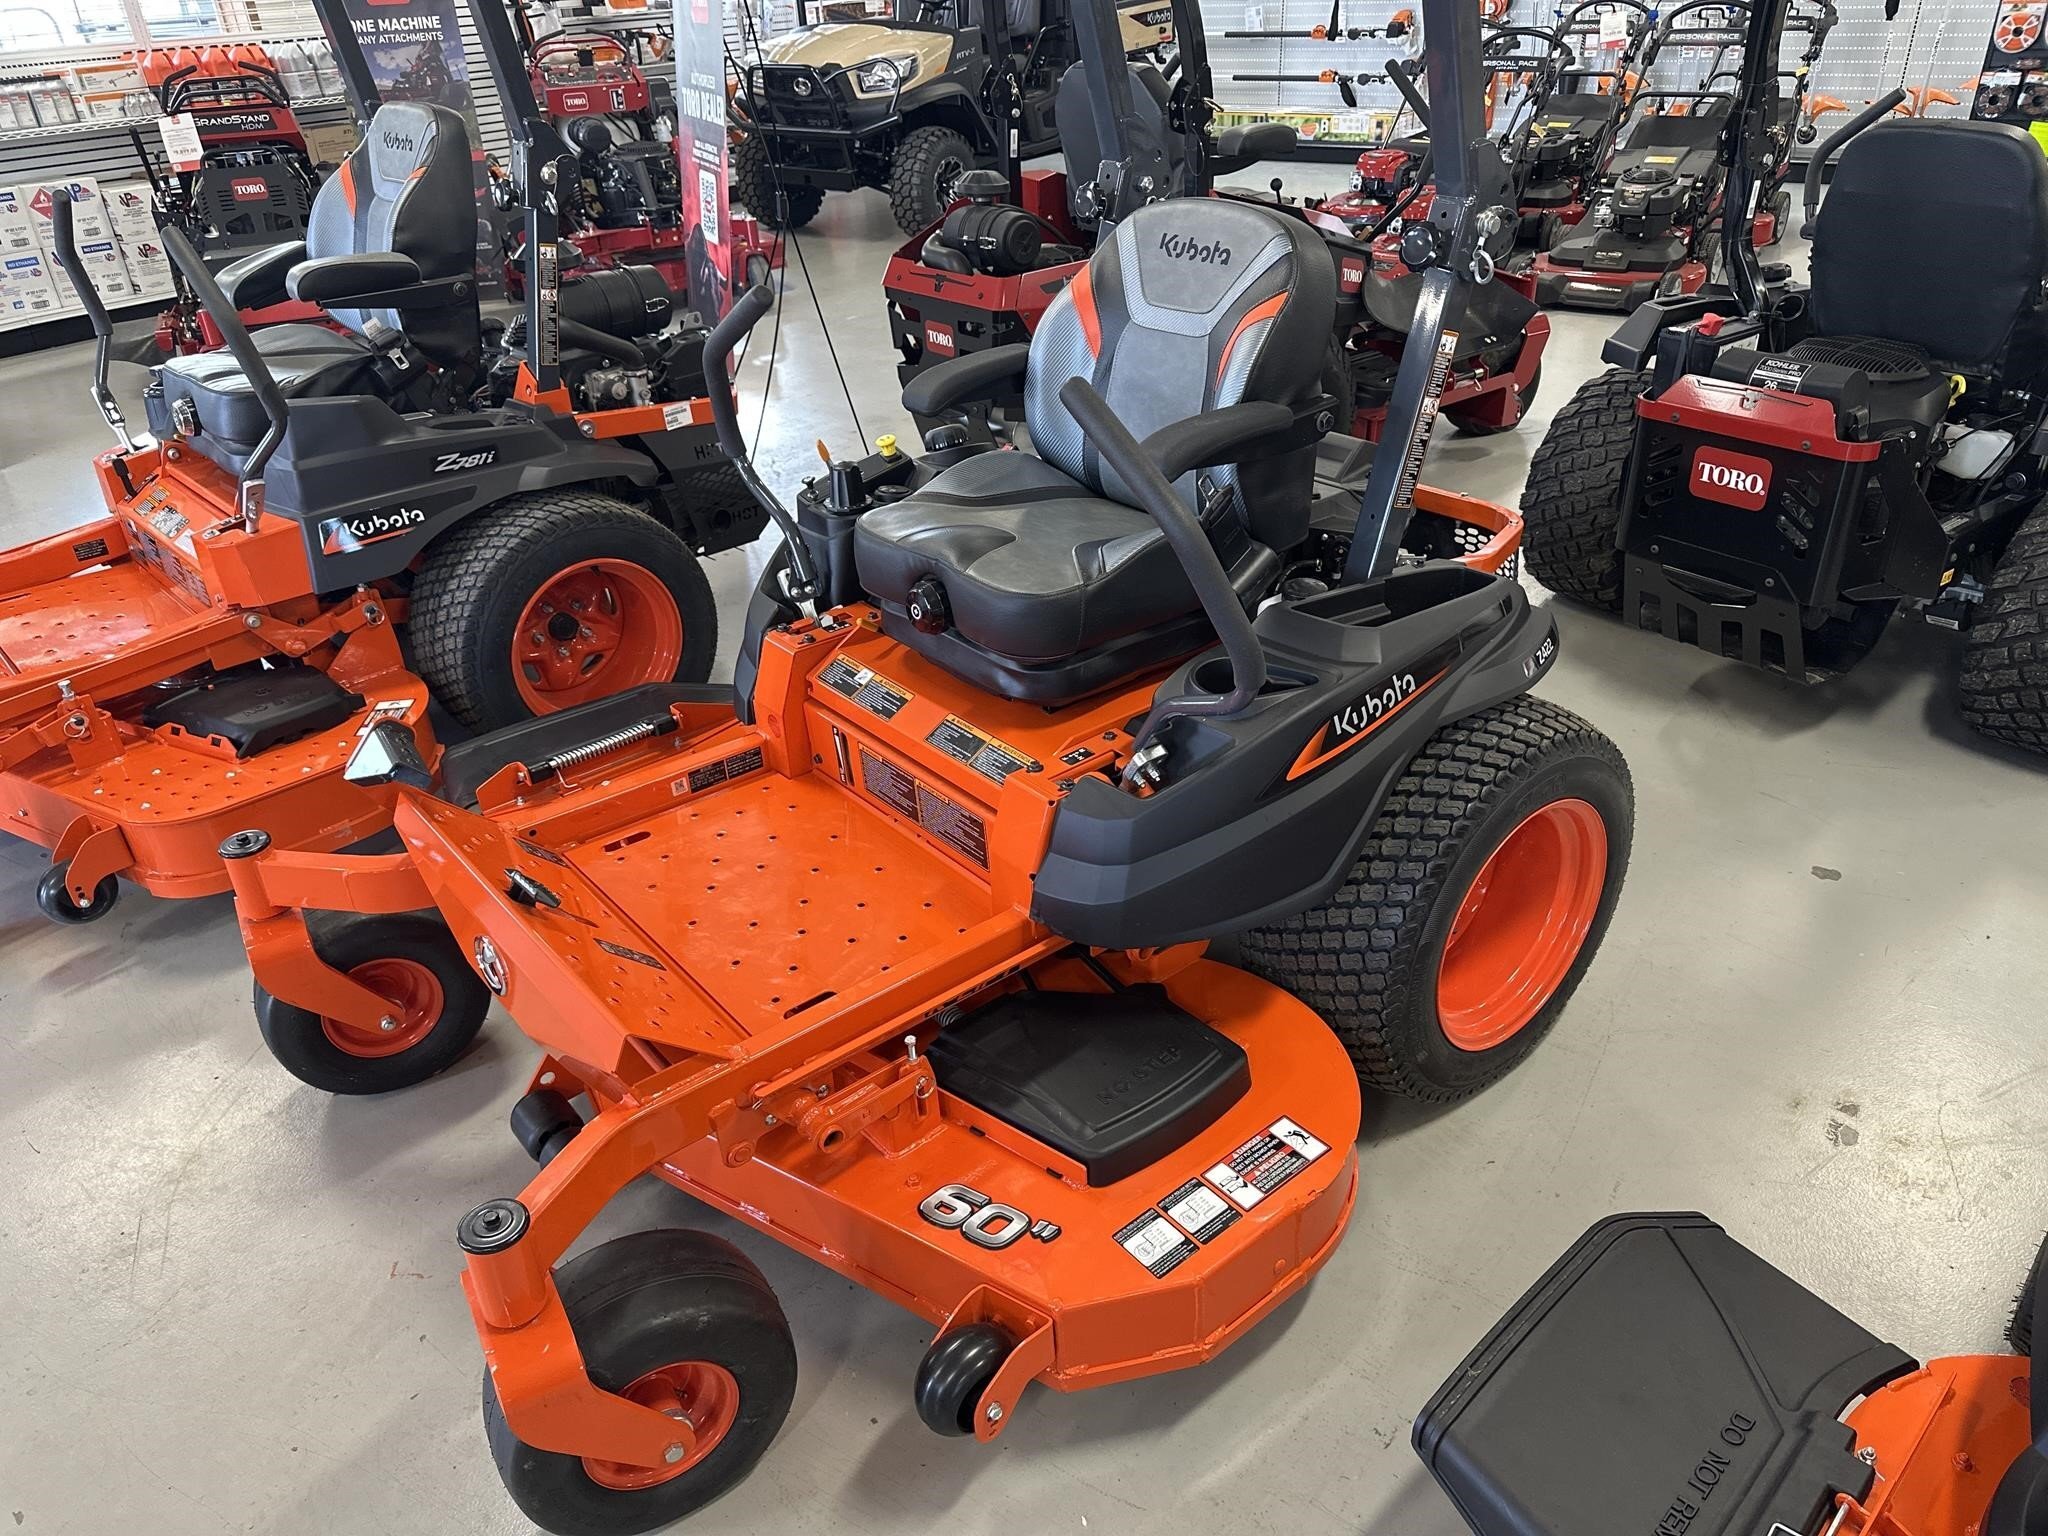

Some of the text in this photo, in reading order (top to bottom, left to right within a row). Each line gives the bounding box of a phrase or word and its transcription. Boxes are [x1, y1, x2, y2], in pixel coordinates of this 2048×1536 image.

[378, 16, 441, 31] MACHINE
[1147, 10, 1170, 24] Kubota
[379, 32, 444, 43] ATTACHMENTS
[566, 97, 587, 107] TORO
[682, 87, 701, 119] TORO
[241, 122, 265, 131] HDM
[384, 131, 413, 152] Kubota
[235, 183, 266, 195] TORO
[1159, 232, 1232, 266] Kubota
[1343, 267, 1363, 283] TORO
[928, 330, 953, 348] TORO
[1766, 359, 1800, 371] KOHLER
[1764, 380, 1778, 391] 26
[434, 450, 496, 473] Z781i
[1698, 462, 1765, 496] TORO
[344, 508, 426, 537] Kubota
[1535, 637, 1555, 665] Z422
[1333, 672, 1417, 736] Kubota
[1236, 1135, 1262, 1154] DANGER
[1257, 1151, 1286, 1171] PELIGRO
[1720, 1411, 1756, 1446] DO
[1687, 1450, 1730, 1500] NOT
